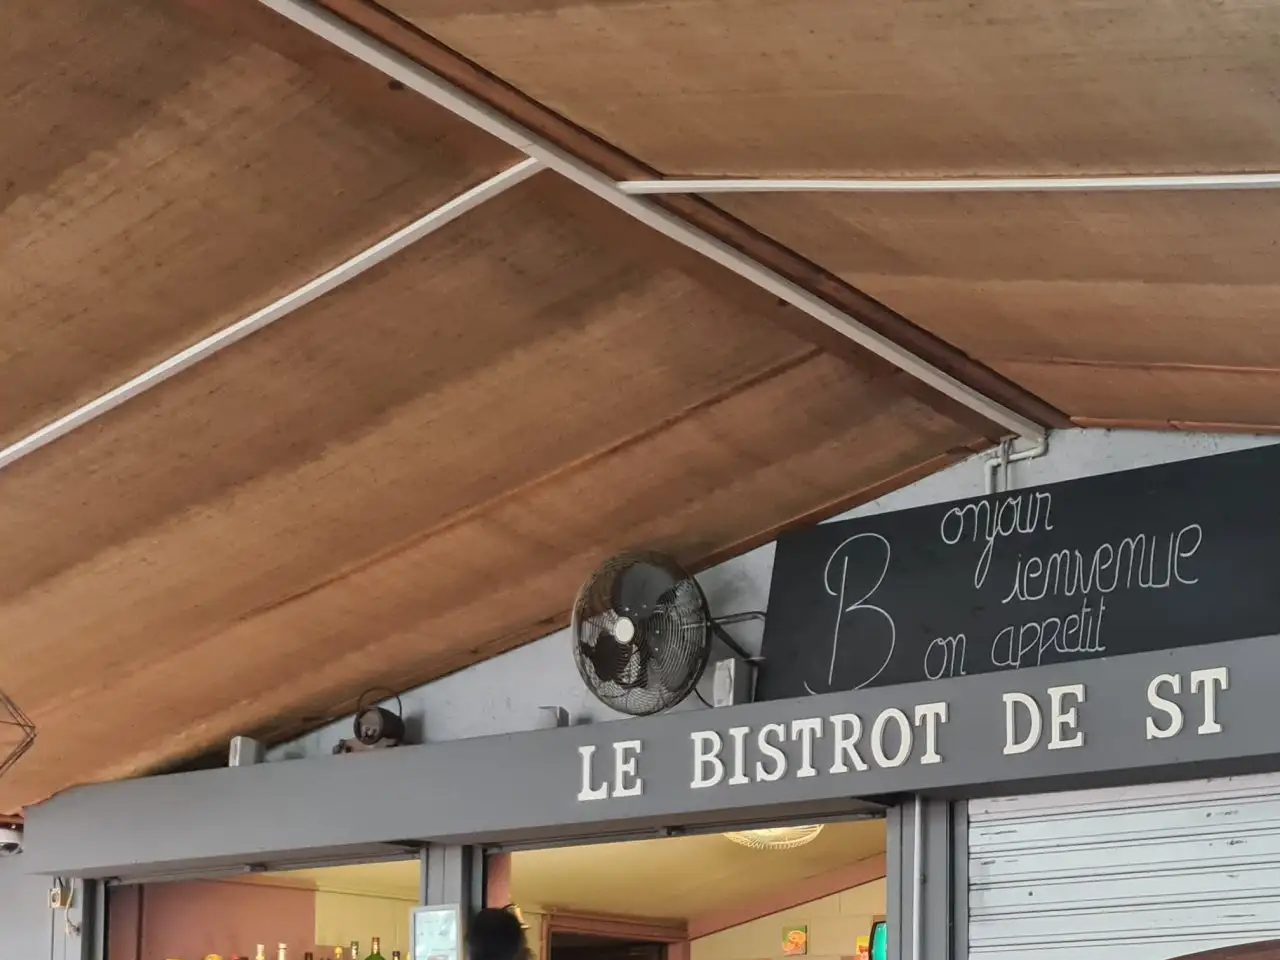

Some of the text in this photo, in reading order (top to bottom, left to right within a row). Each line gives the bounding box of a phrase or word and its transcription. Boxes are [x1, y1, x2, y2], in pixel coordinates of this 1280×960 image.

[804, 532, 896, 695] B
[924, 633, 967, 681] on
[577, 740, 643, 802] LE
[690, 702, 949, 790] BISTROT
[1002, 683, 1087, 755] DE
[1145, 666, 1230, 740] ST
